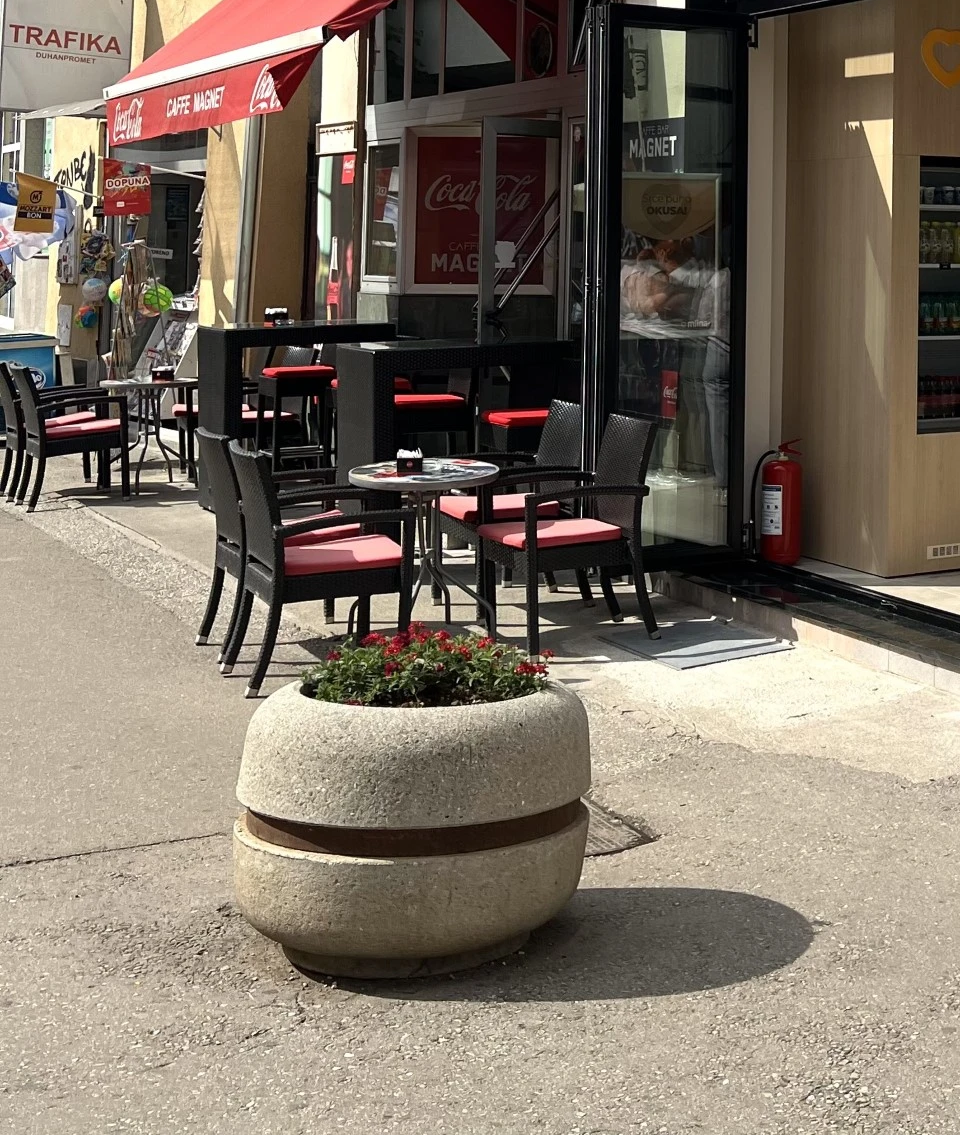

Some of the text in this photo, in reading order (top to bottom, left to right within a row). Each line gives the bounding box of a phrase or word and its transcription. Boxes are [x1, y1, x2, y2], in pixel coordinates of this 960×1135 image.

[9, 24, 122, 55] TRAFIKA
[35, 51, 97, 64] DUHANPROMET
[166, 85, 226, 118] CAFFE MAGNET
[629, 135, 678, 159] MAGNET
[107, 176, 149, 188] DOPUNA
[431, 253, 529, 272] MAGT
